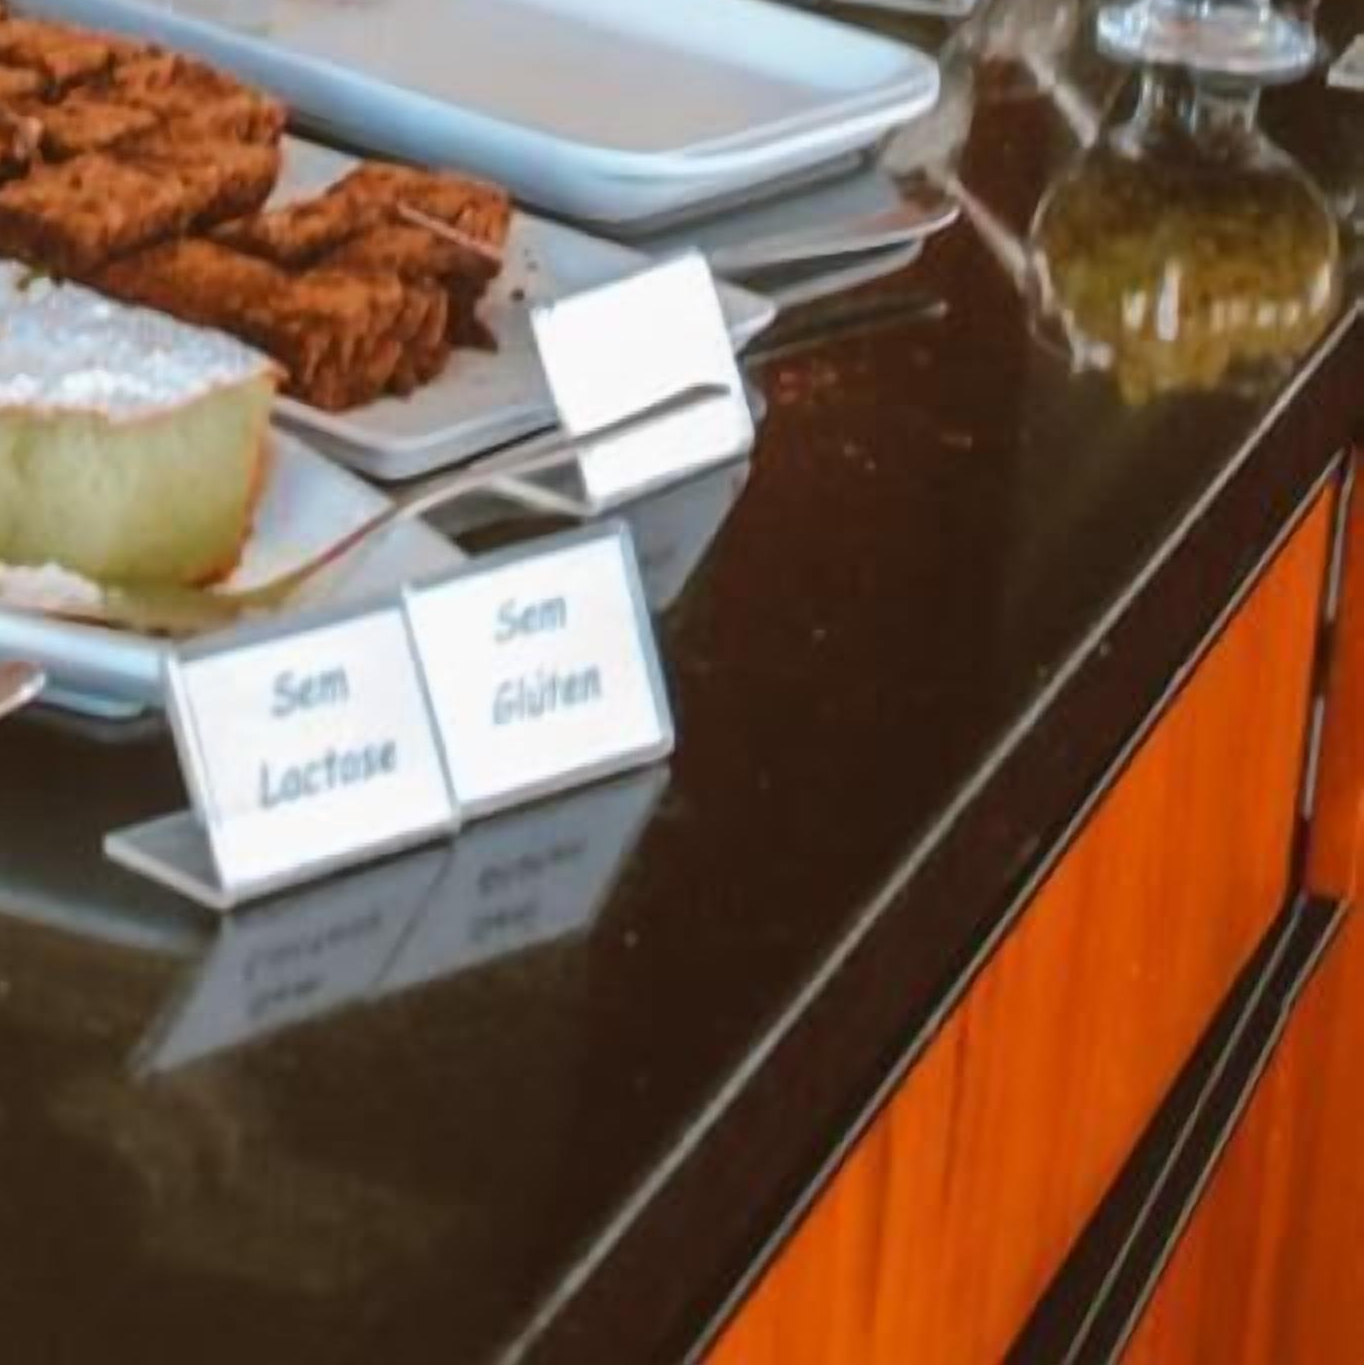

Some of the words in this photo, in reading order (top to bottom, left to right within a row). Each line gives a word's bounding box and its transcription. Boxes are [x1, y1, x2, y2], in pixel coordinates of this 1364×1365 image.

[493, 595, 567, 644] Sem
[271, 665, 350, 718] Sem
[258, 739, 397, 810] Lactose
